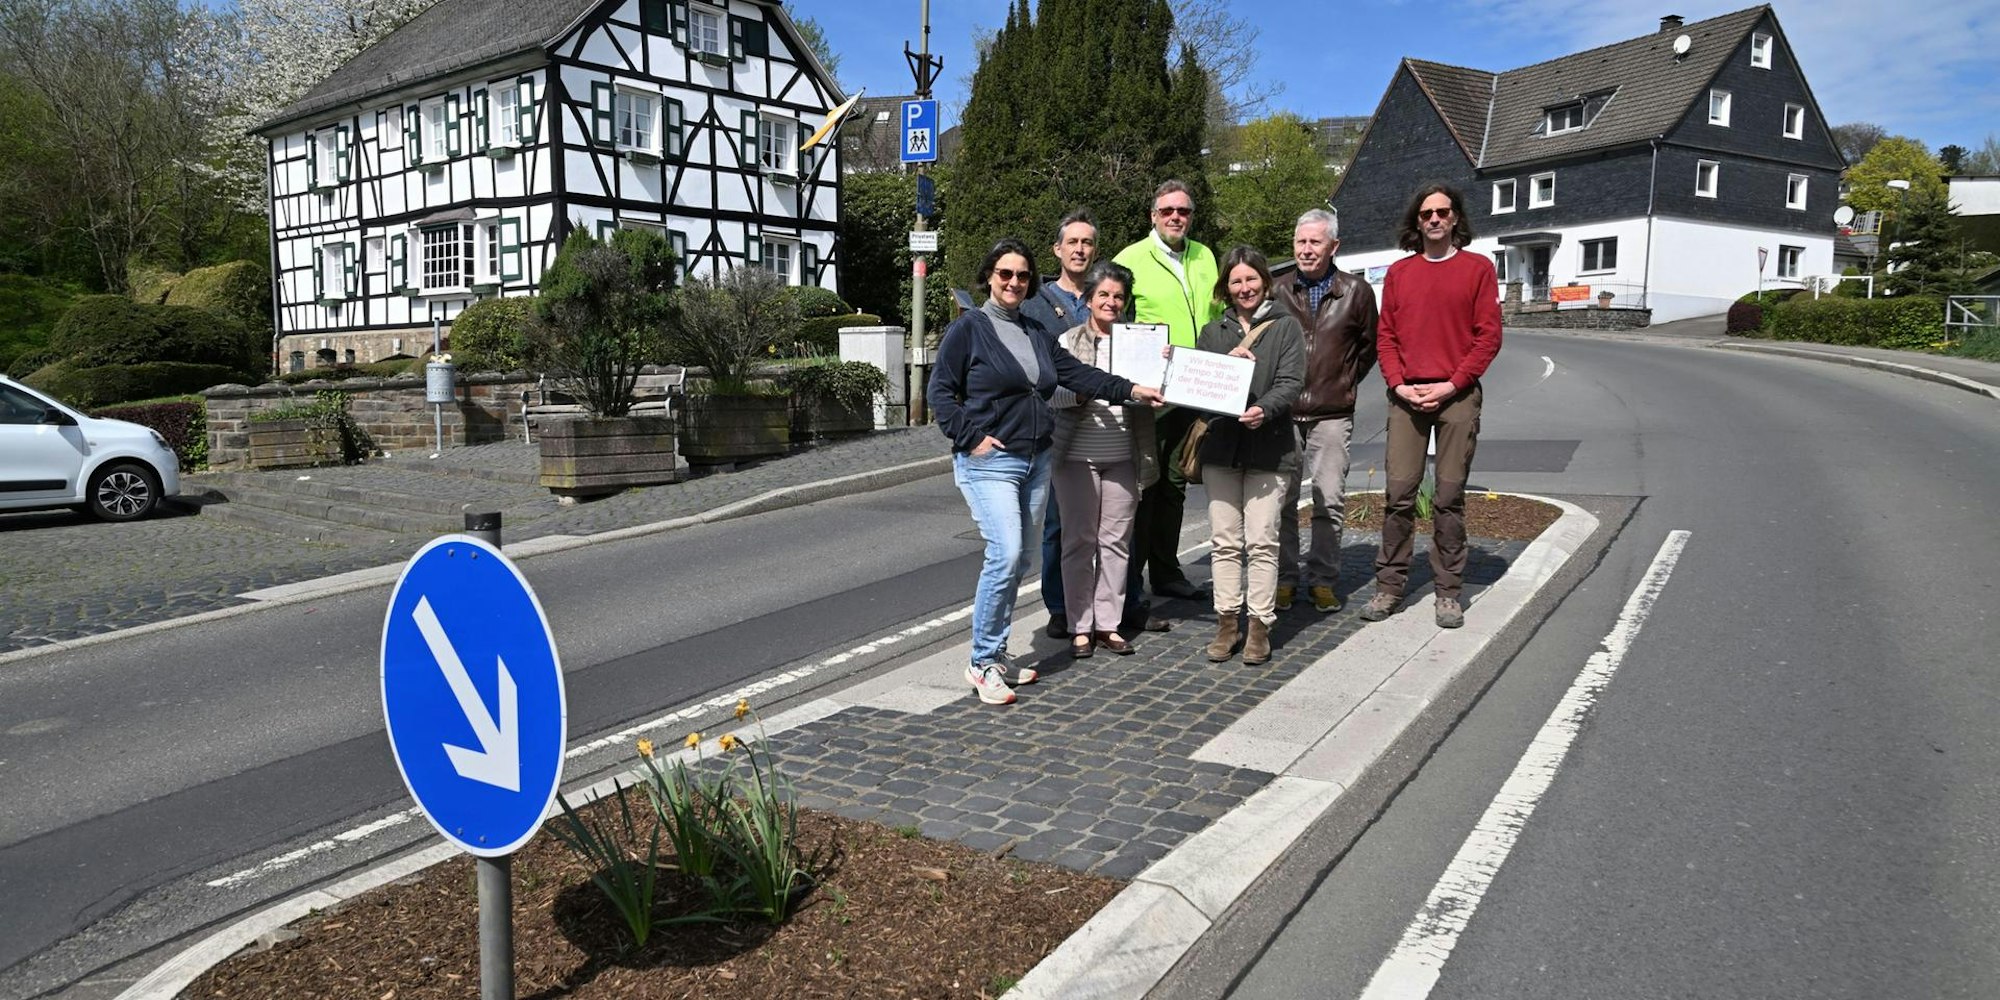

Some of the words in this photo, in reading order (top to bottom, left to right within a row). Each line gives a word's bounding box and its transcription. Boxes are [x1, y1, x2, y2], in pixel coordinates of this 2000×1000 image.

[907, 104, 922, 127] P
[1188, 356, 1203, 364] Wir
[1184, 365, 1212, 377] Tempo
[1214, 370, 1225, 379] 30
[1178, 375, 1192, 384] der
[1194, 377, 1239, 393] Bergstraße
